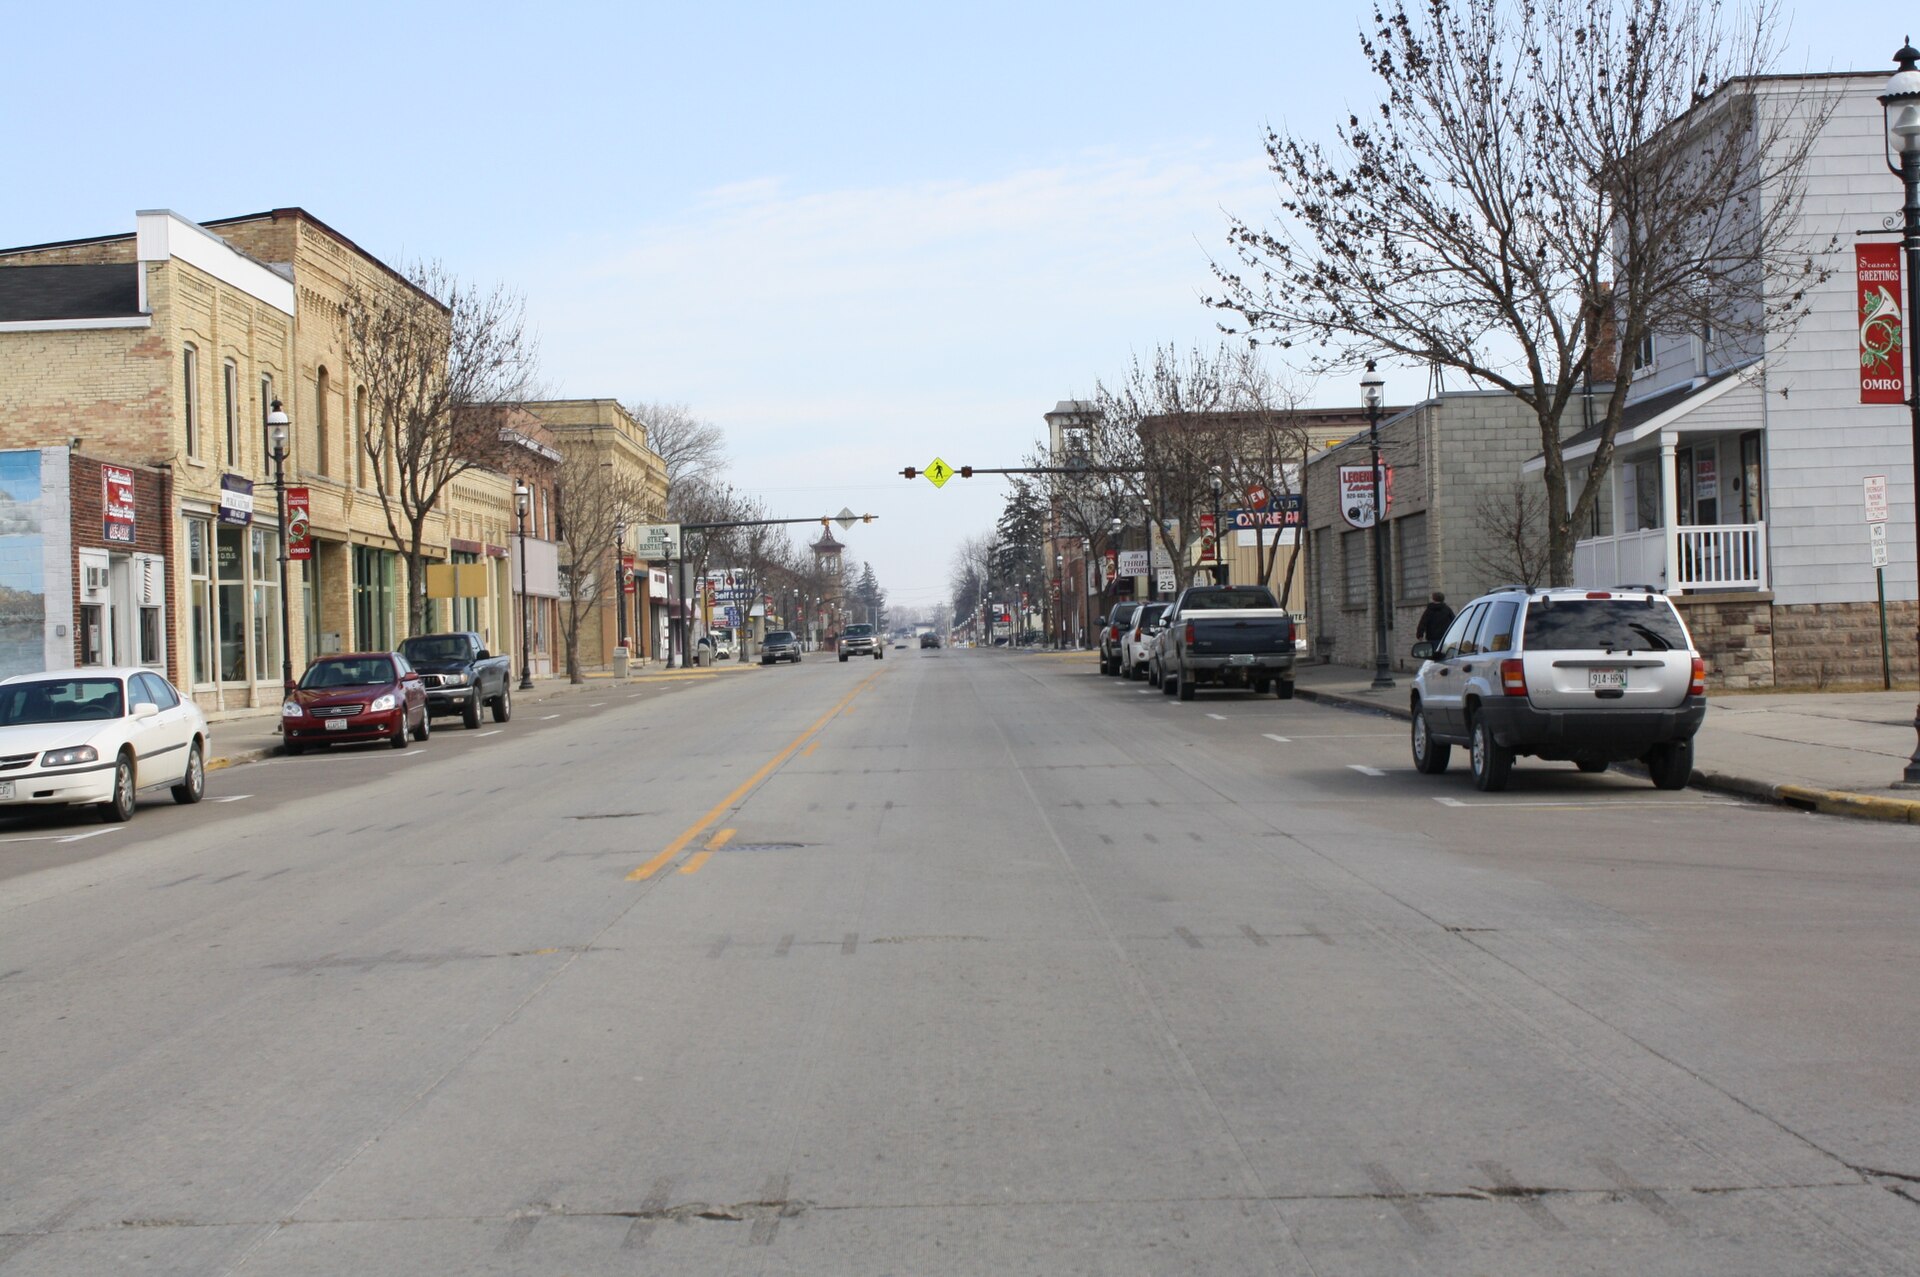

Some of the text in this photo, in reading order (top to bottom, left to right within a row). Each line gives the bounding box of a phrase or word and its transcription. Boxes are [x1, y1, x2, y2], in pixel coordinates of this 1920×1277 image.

[1859, 256, 1897, 269] Season's
[1859, 270, 1899, 282] GREETINGS
[1862, 378, 1902, 390] OMRO
[1124, 560, 1149, 568] THRIF
[1160, 581, 1175, 591] 25
